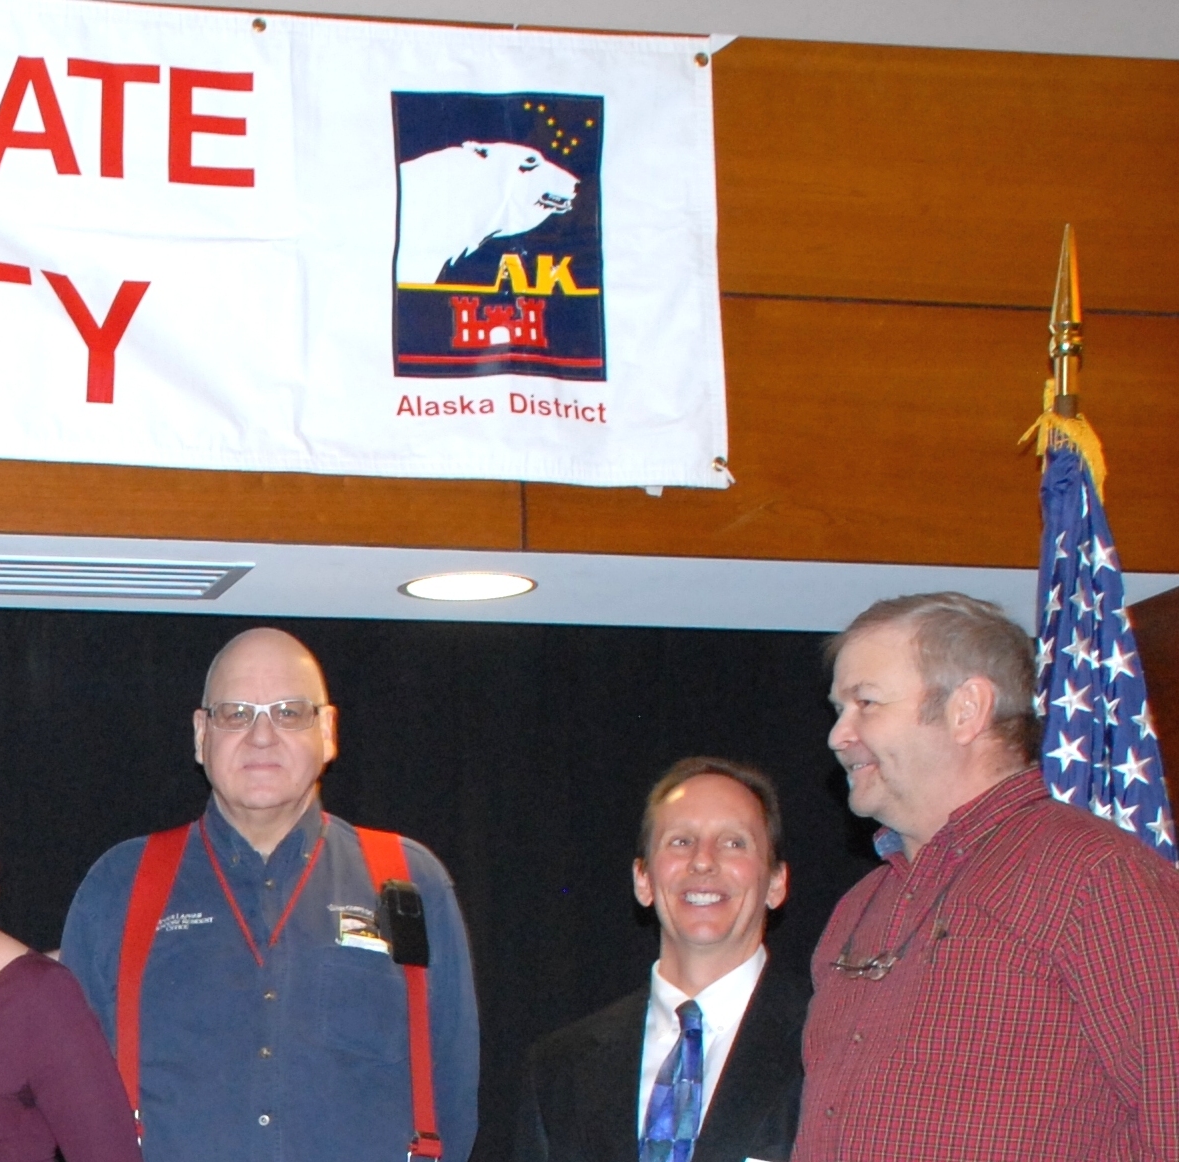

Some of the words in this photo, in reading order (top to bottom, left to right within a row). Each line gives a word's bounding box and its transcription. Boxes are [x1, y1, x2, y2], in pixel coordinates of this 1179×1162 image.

[494, 253, 579, 296] AK
[396, 395, 495, 417] Alaska
[509, 392, 607, 424] District
